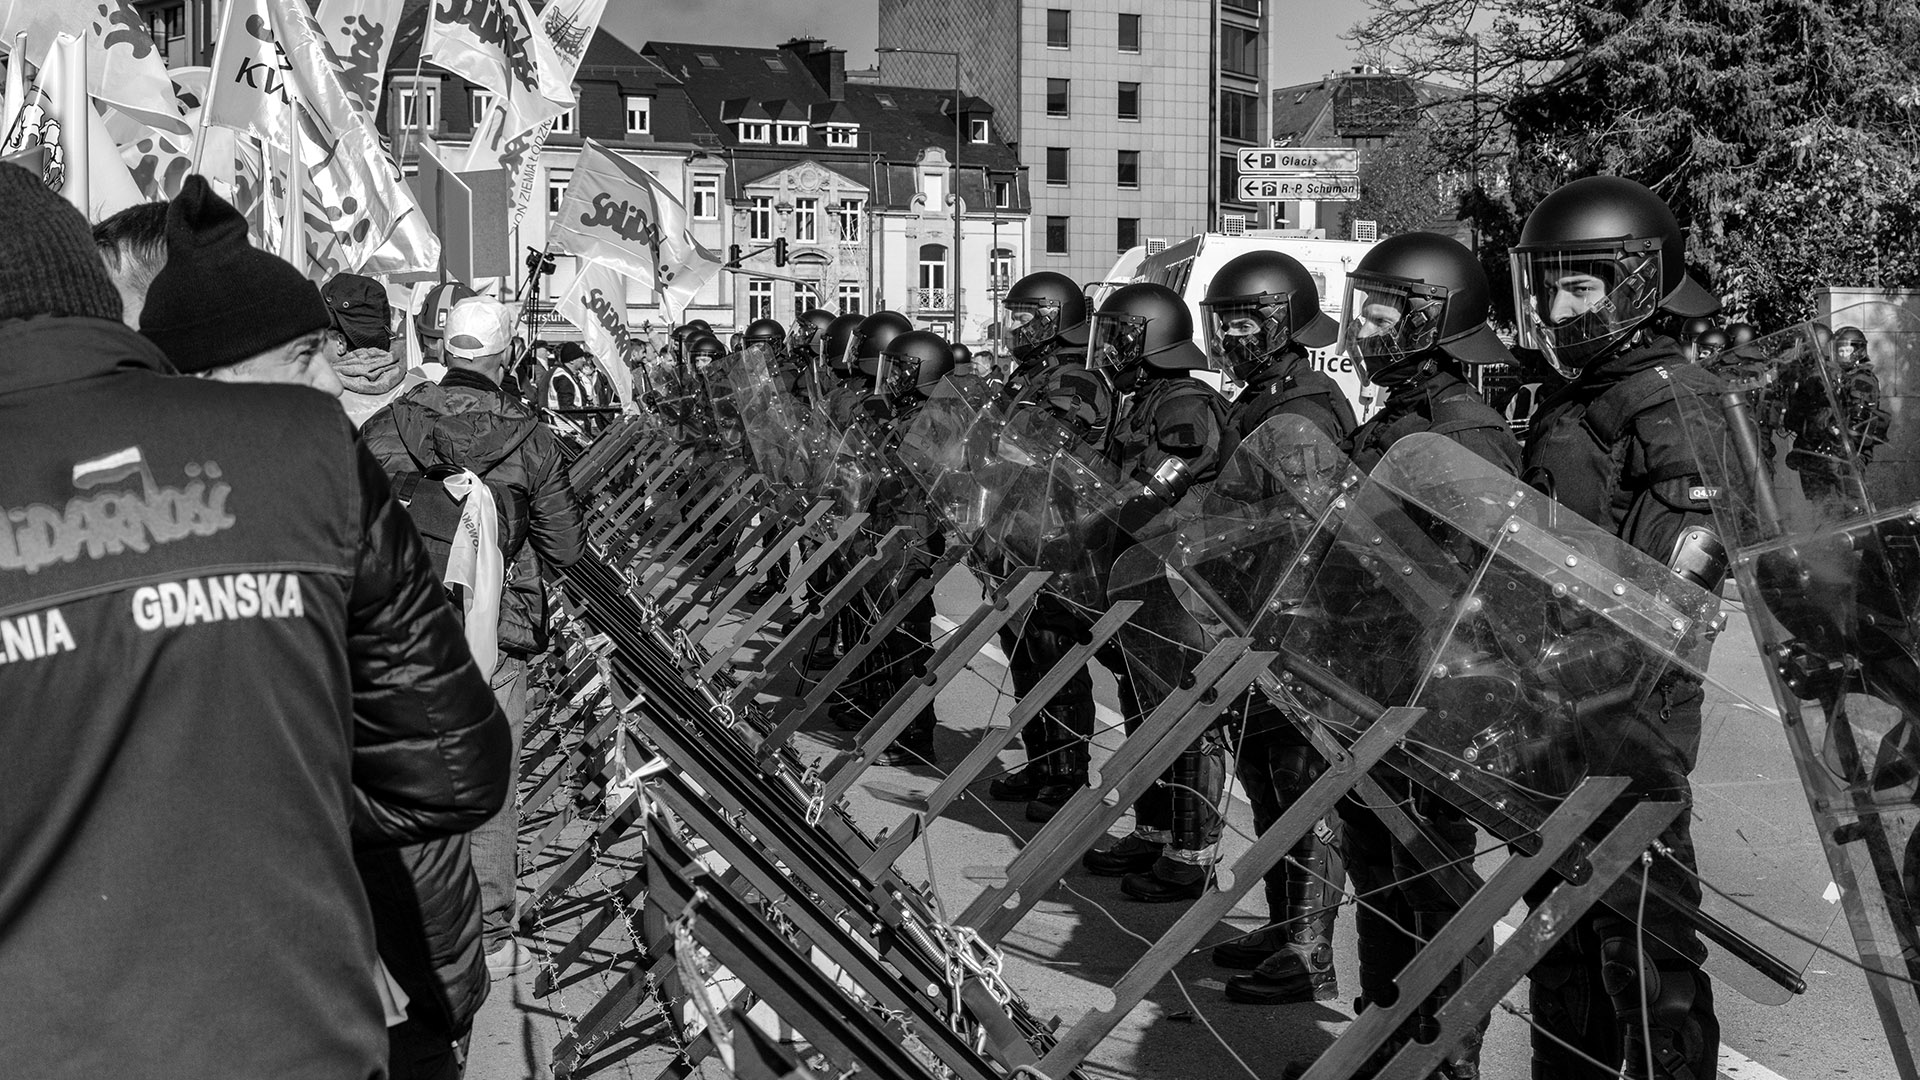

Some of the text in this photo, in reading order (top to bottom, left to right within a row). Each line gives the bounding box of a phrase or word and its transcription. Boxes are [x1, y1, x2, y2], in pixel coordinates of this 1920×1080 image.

[1282, 156, 1318, 167] Glacis
[520, 164, 536, 202] ZIEMIA
[1306, 183, 1355, 194] Schuman
[1309, 350, 1353, 373] lice
[0, 572, 304, 665] NIA GDANSKA
